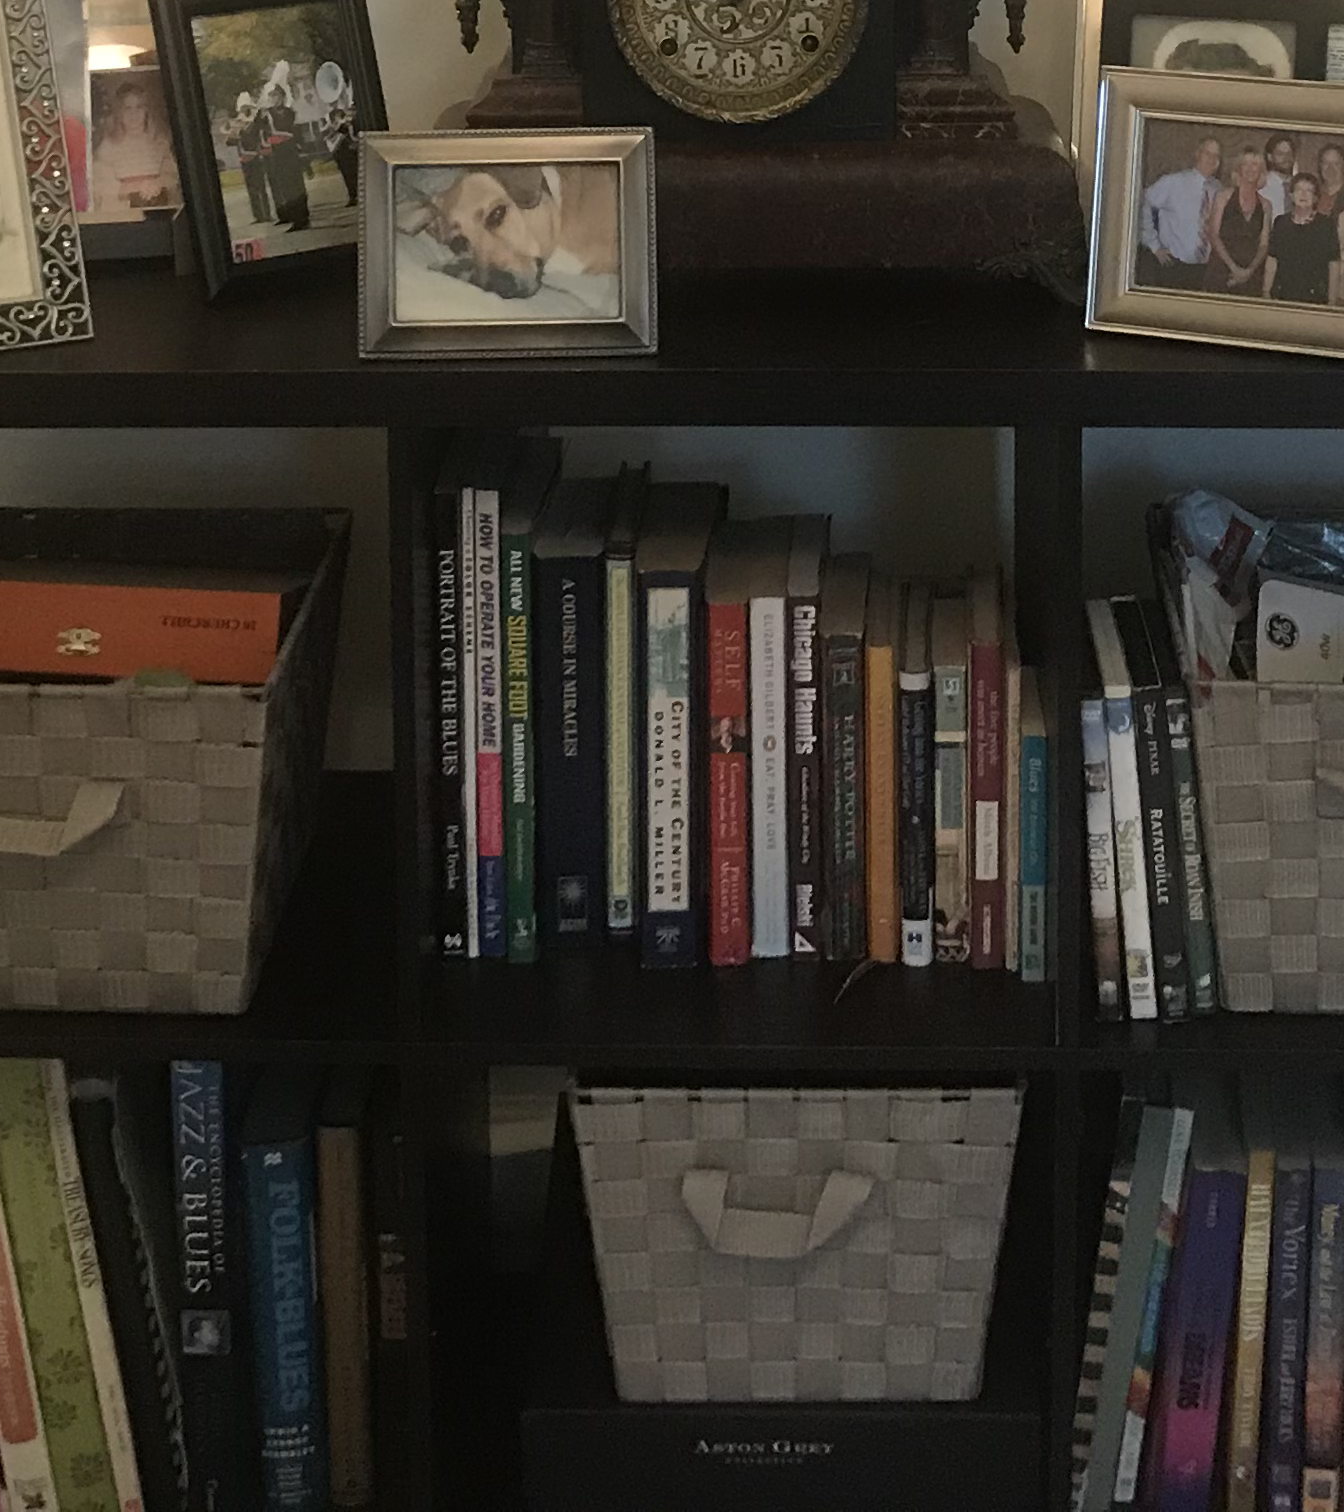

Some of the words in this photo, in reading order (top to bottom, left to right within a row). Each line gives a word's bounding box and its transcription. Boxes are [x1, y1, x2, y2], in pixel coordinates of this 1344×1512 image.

[694, 46, 708, 70] 7
[480, 513, 494, 550] HOW
[480, 554, 494, 574] TO
[509, 550, 524, 573] ALL
[561, 579, 576, 590] A
[438, 550, 456, 643] PORTRAIT
[481, 580, 495, 649] OPERATE
[509, 576, 525, 611] NEW
[506, 615, 528, 676] SQUARE
[562, 594, 577, 654] COURSE
[763, 614, 776, 677] ELIZABETH
[790, 605, 817, 682] Chicago
[440, 647, 457, 671] OF
[481, 655, 496, 696] YOUR
[562, 658, 577, 675] IN
[723, 630, 742, 692] SELF
[441, 677, 458, 713] THE
[507, 680, 529, 720] FOOT
[764, 681, 776, 730] GILBERT
[1143, 700, 1158, 736] Disney
[482, 701, 497, 747] HOME
[563, 679, 578, 758] MIRACLES
[670, 700, 684, 740] CITY
[793, 687, 818, 755] Haunts
[440, 718, 459, 776] BLUES
[512, 723, 528, 804] GARDENING
[654, 711, 664, 788] DONALD
[671, 749, 682, 770] OF
[842, 714, 856, 784] HARRY
[1147, 740, 1161, 777] PIXAR
[671, 778, 682, 809] THE
[1028, 757, 1043, 793] Blues
[766, 822, 777, 850] LOVE
[1179, 796, 1197, 842] SECRET
[654, 825, 665, 895] MILLER
[670, 817, 685, 902] CENTURY
[1149, 808, 1172, 906] RATATOUILLE
[176, 1065, 206, 1144] JAZZ
[180, 1153, 208, 1181] &
[207, 1124, 224, 1247] ENCYCLOPEDIA
[182, 1193, 213, 1294] BLUES
[211, 1252, 226, 1273] OF
[694, 1439, 766, 1455] ASTON
[772, 1439, 835, 1456] GREY
